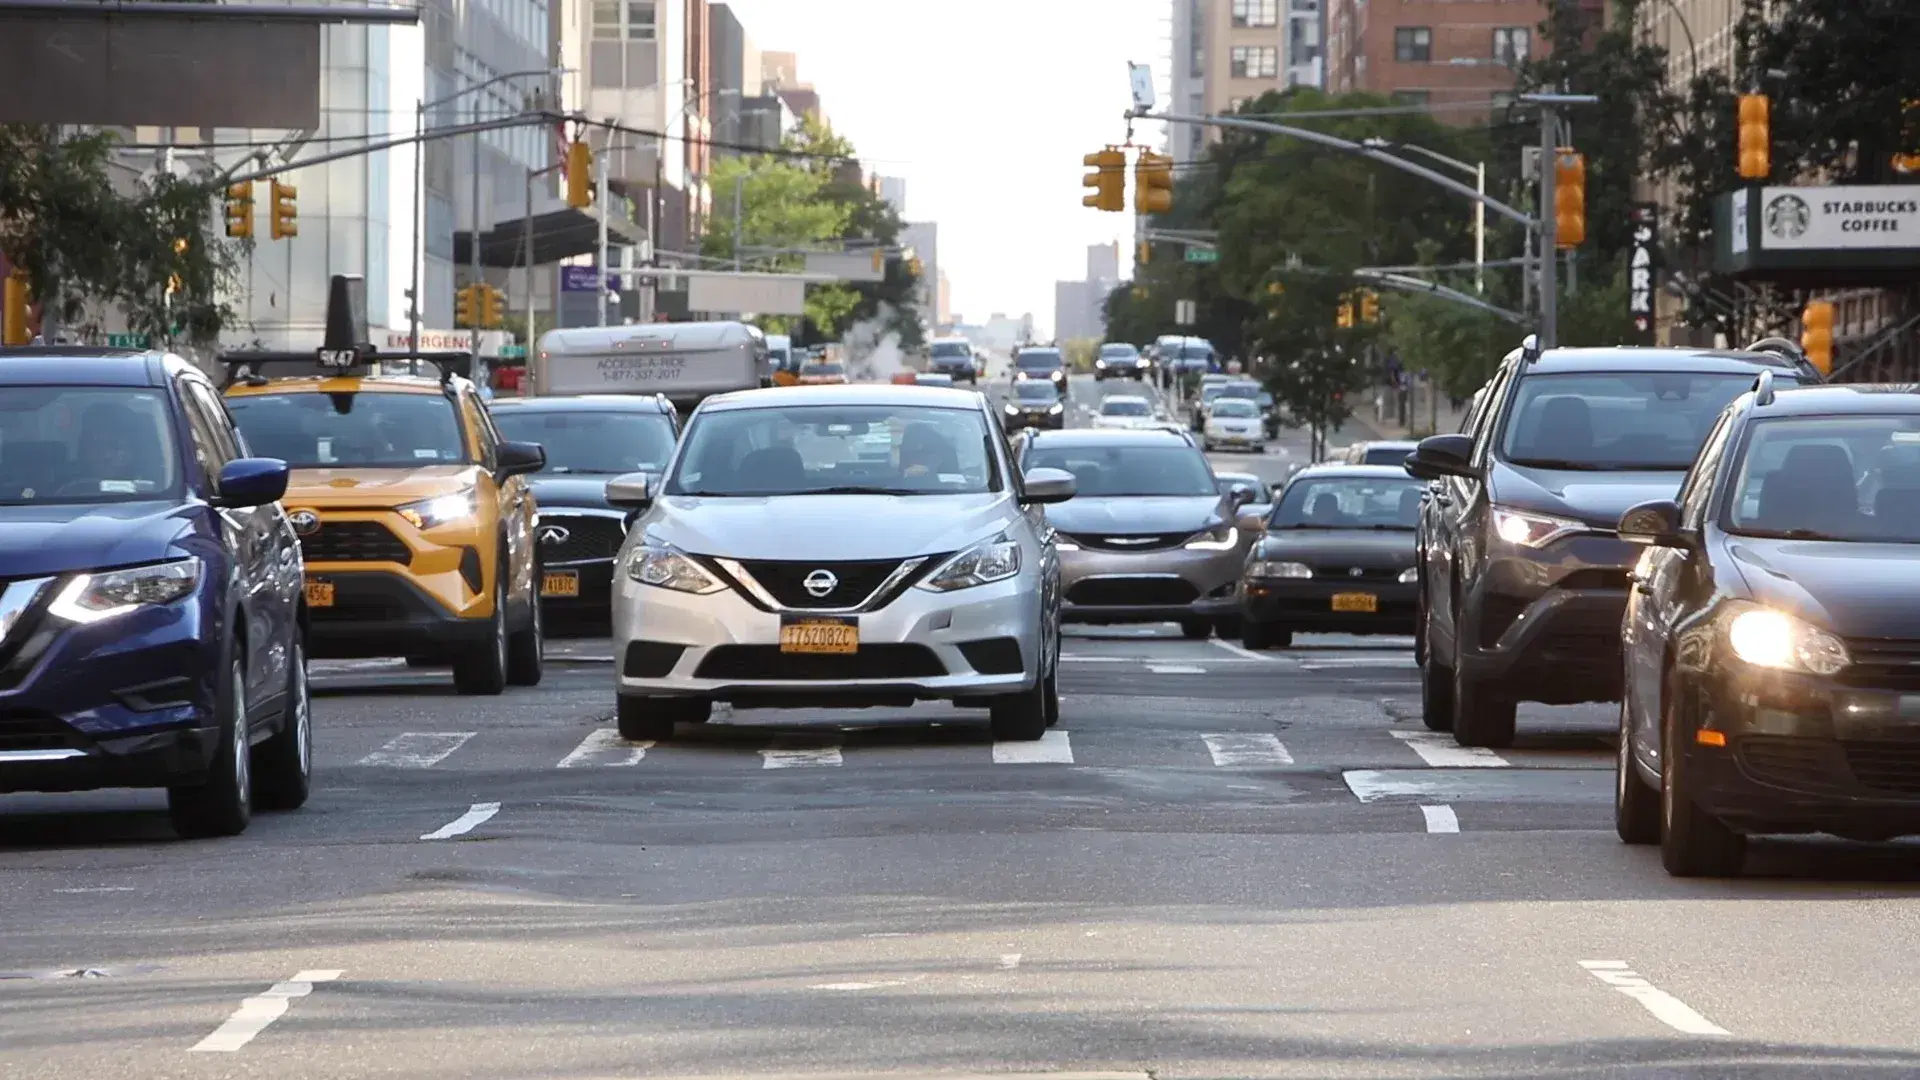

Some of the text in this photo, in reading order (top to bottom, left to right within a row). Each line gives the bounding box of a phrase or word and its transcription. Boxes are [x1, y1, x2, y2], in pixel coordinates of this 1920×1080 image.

[1823, 201, 1917, 215] STARBUCKS
[1841, 218, 1899, 232] COFFEE
[387, 334, 484, 349] EMRGENC
